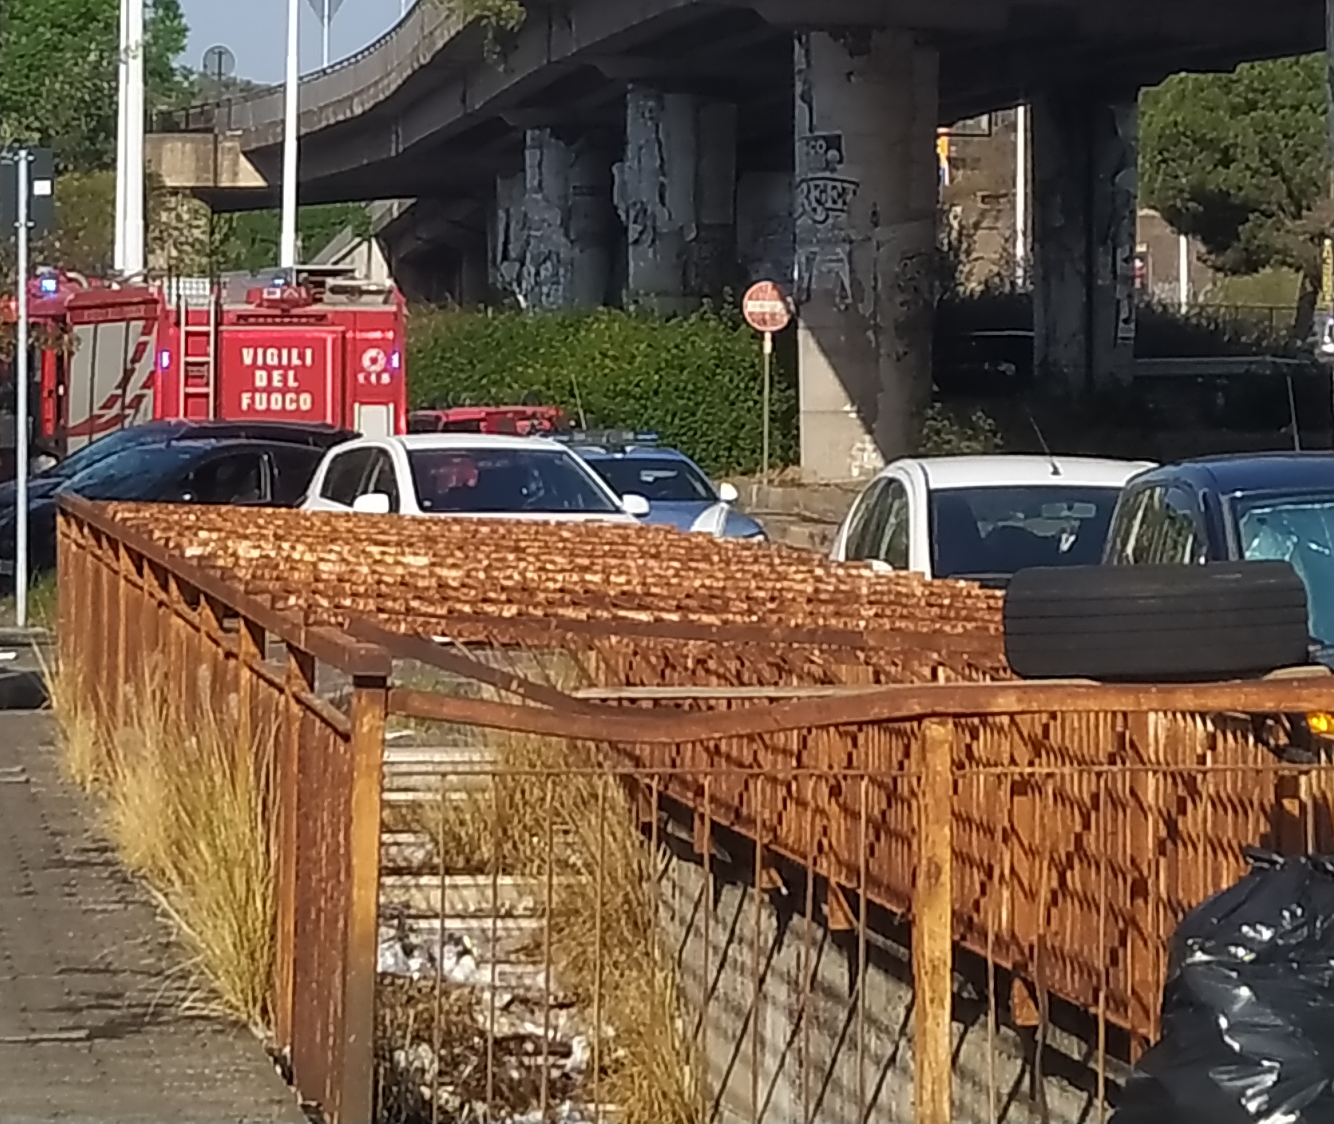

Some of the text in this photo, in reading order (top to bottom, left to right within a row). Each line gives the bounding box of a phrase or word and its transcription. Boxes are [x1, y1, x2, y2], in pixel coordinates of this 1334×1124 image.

[241, 347, 313, 367] VIGILI
[254, 369, 299, 388] DEL
[241, 392, 312, 411] FUOCO
